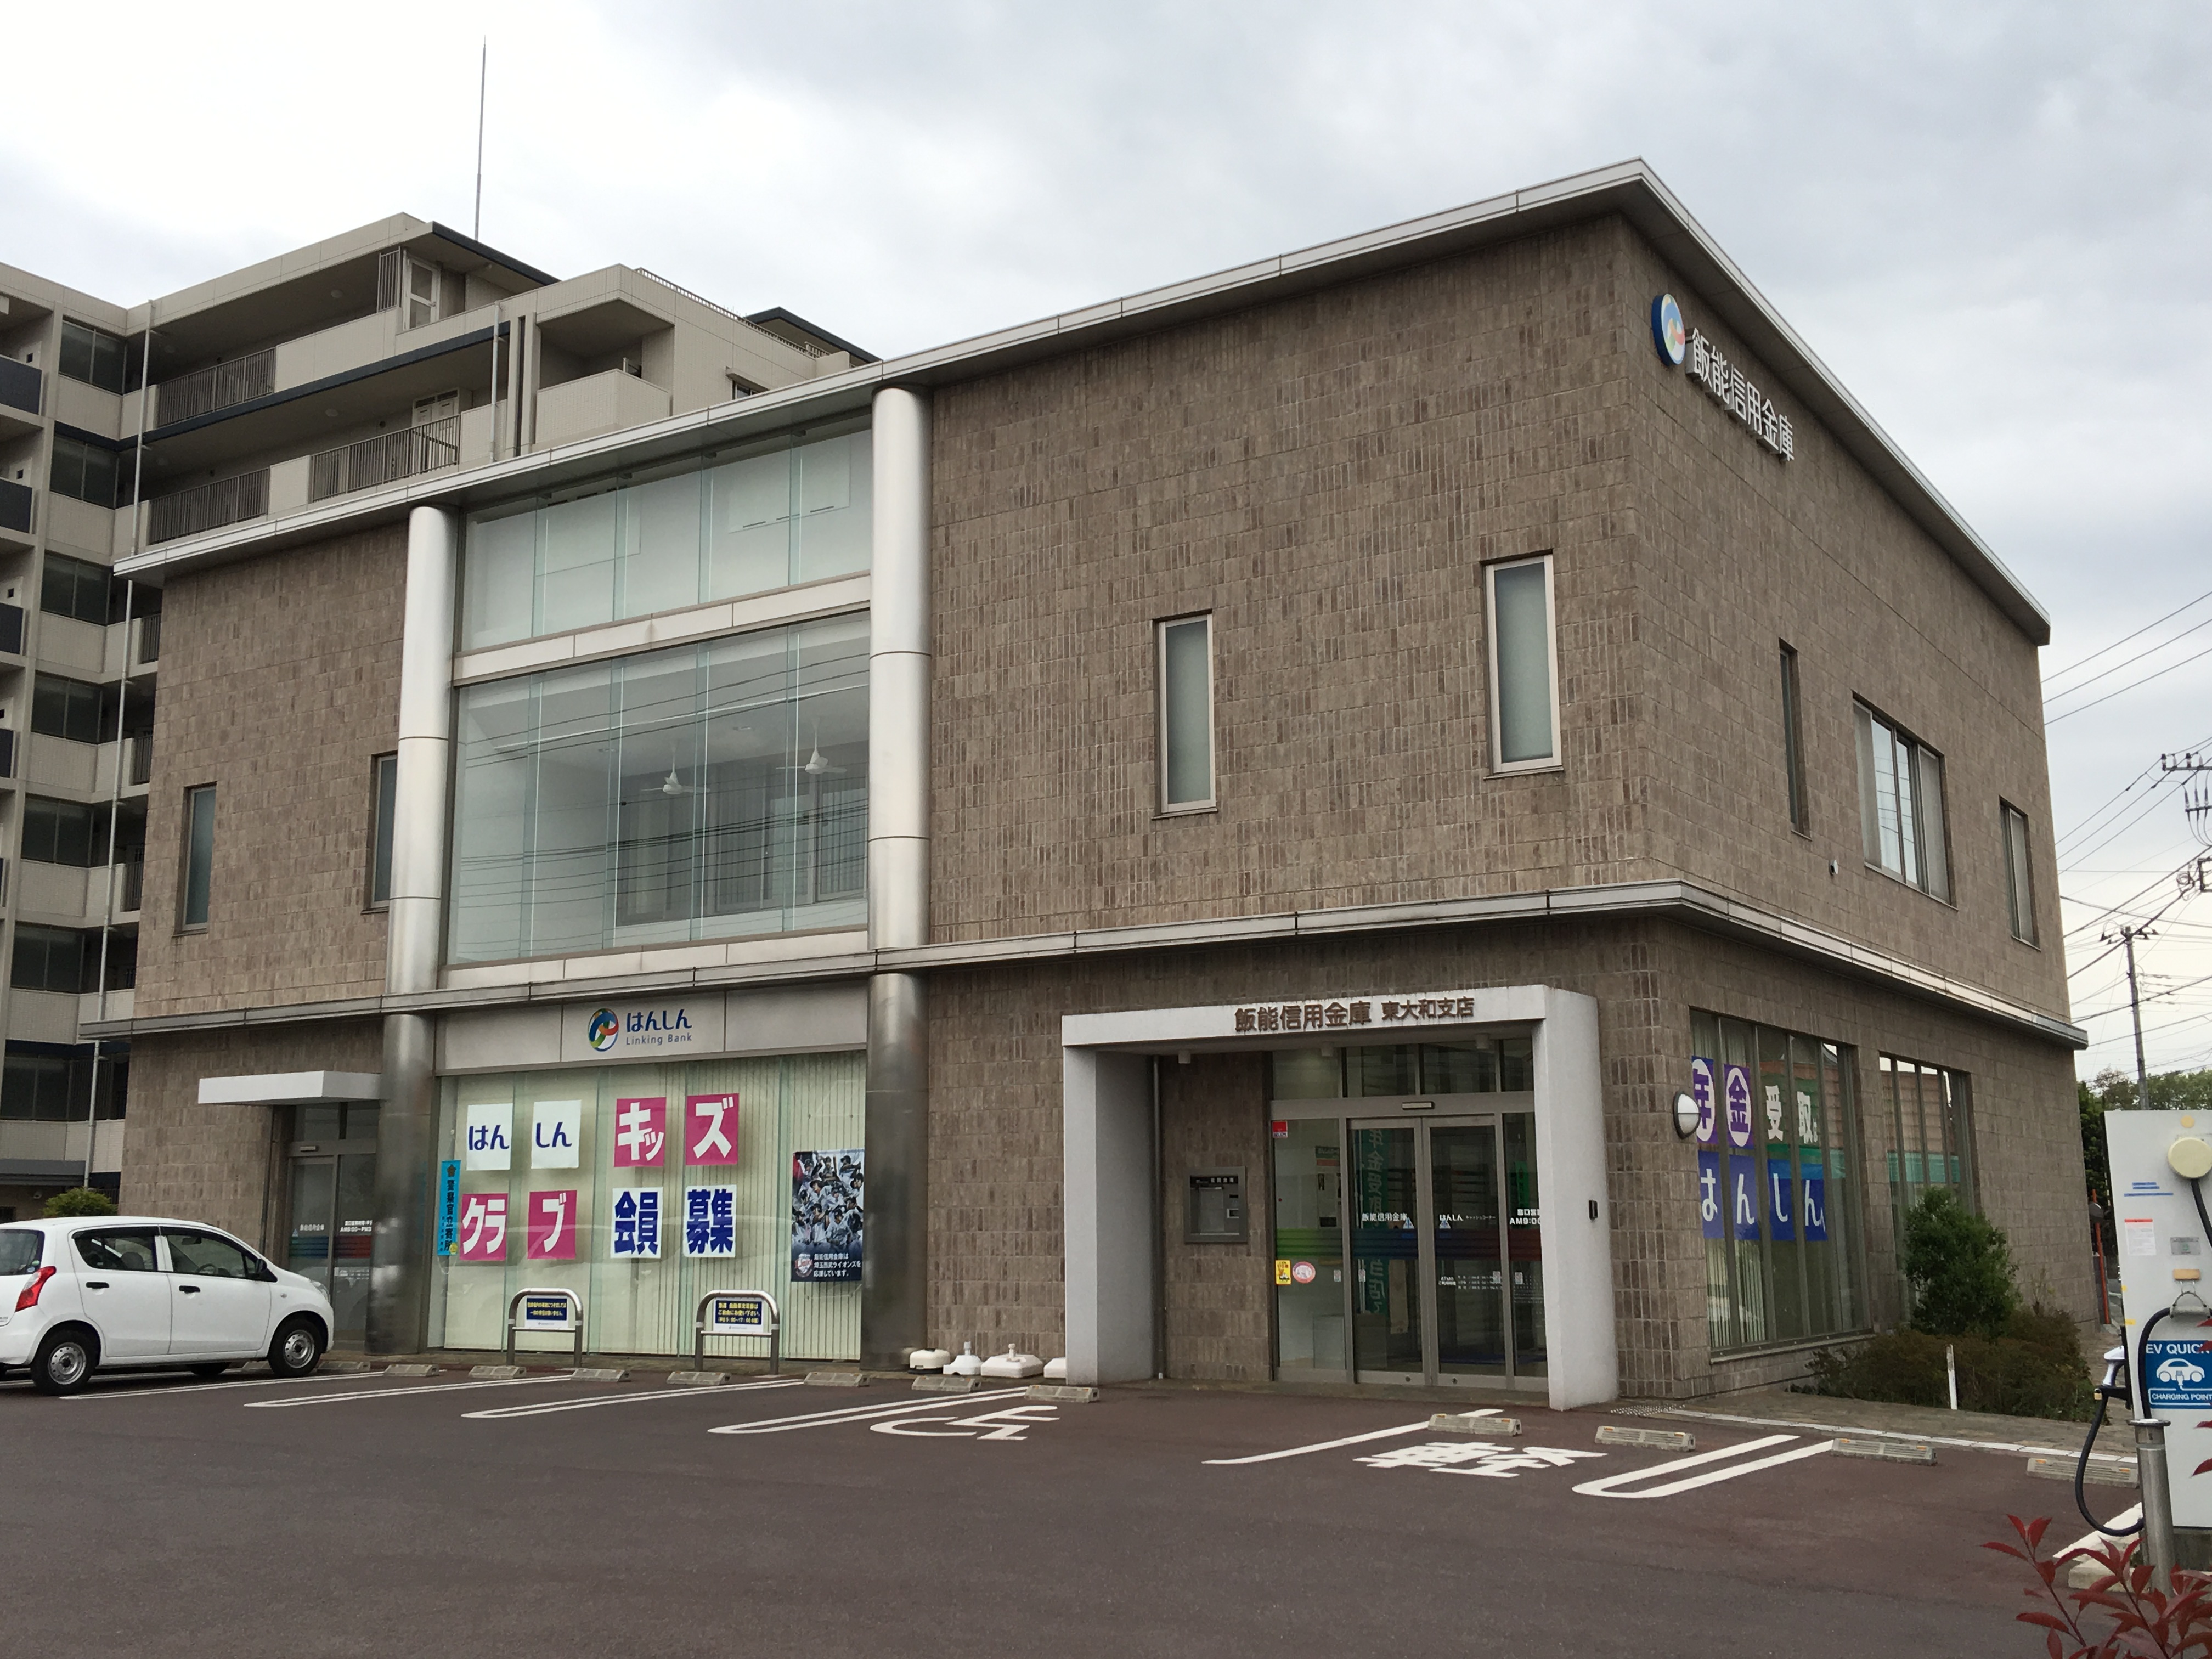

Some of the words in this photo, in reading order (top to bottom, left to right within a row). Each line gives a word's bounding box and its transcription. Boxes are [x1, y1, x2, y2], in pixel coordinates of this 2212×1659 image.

[1692, 328, 1794, 461] 飯能信用金庫
[627, 1008, 692, 1032] はんしん
[1234, 1000, 1372, 1032] 飯能信用金庫
[1381, 996, 1475, 1022] 東大和支店
[626, 1035, 663, 1046] Linking
[668, 1032, 692, 1043] Bank
[469, 1121, 572, 1150] はんしん
[618, 1096, 734, 1161] キッズ
[462, 1192, 567, 1254] クラブ
[614, 1189, 733, 1255] 会員募集
[2146, 1344, 2162, 1354] EV
